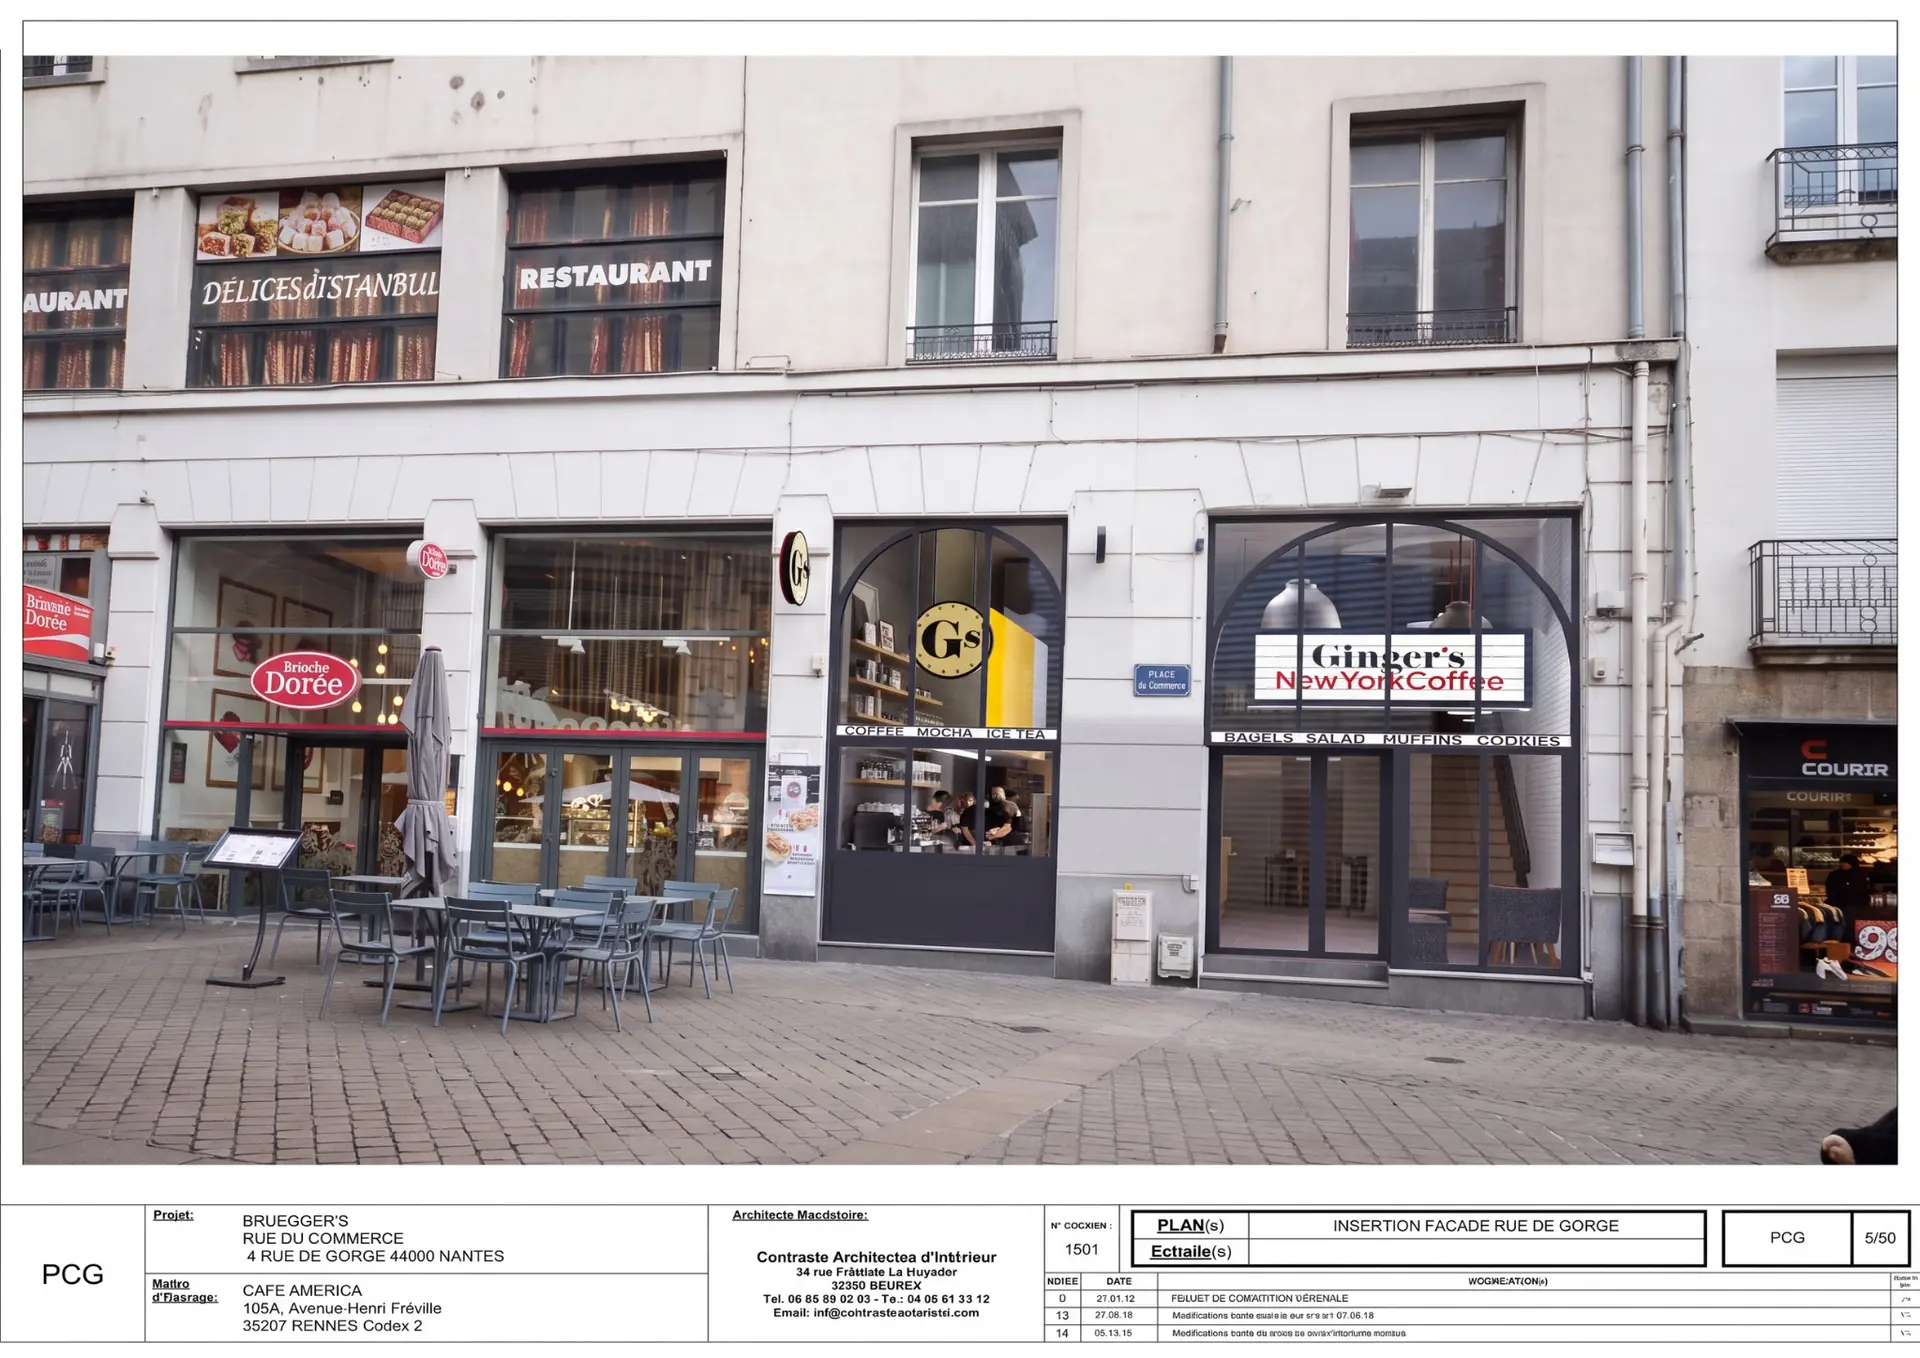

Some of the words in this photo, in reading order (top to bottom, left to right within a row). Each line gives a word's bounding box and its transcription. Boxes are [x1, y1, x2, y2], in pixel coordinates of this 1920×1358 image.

[520, 259, 712, 290] RESTAURANT
[23, 288, 128, 313] AURANT
[791, 549, 811, 588] Gs
[25, 609, 68, 631] Dorée
[921, 619, 981, 659] Gs
[1312, 643, 1465, 673] Ginger's
[283, 661, 330, 674] Brioche
[1148, 670, 1176, 679] PLACE
[264, 671, 343, 696] Dorée
[1148, 681, 1186, 690] Commerce
[844, 725, 905, 736] COFFEE
[917, 727, 973, 738] MOCHA
[986, 729, 1011, 739] ICE
[1016, 730, 1045, 740] TEA
[1224, 732, 1294, 744] BAGELS
[1306, 733, 1365, 745] SALAD
[1383, 734, 1463, 746] MUFFINS
[1801, 762, 1889, 777] COURIR
[152, 1209, 195, 1223] Projet:
[243, 1214, 349, 1228] BRUEGGER'S
[732, 1209, 794, 1222] Architecte
[1157, 1218, 1225, 1234] PLAN(s)
[1333, 1219, 1421, 1233] INSERTION
[1425, 1219, 1490, 1233] FACADE
[1494, 1219, 1528, 1233] RUE
[1532, 1219, 1555, 1233] DE
[1559, 1219, 1620, 1233] GORGE
[243, 1232, 277, 1245] RUE
[281, 1232, 304, 1245] DU
[308, 1232, 404, 1245] COMMERCE
[1770, 1231, 1806, 1244] PCG
[1865, 1231, 1897, 1245] 5/50
[1065, 1243, 1099, 1256] 1501
[247, 1250, 257, 1263] 4
[261, 1250, 295, 1263] RUE
[299, 1250, 322, 1263] DE
[325, 1250, 386, 1263] GORGE
[389, 1250, 435, 1263] 44000
[439, 1250, 505, 1263] NANTES
[757, 1250, 829, 1264] Contraste
[833, 1250, 917, 1264] Architectea
[42, 1263, 104, 1286] PCG
[796, 1267, 811, 1278] 34
[813, 1269, 833, 1278] rue
[888, 1267, 903, 1278] La
[831, 1280, 866, 1291] 32350
[869, 1280, 922, 1291] BEUREX
[1106, 1277, 1133, 1287] DATE
[242, 1284, 286, 1297] CAFE
[288, 1284, 363, 1297] AMERICA
[763, 1294, 785, 1304] Tel.
[787, 1294, 803, 1304] 06
[804, 1294, 820, 1304] 85
[822, 1294, 837, 1304] 89
[839, 1294, 854, 1304] 02
[856, 1294, 871, 1304] 03
[907, 1294, 922, 1304] 04
[924, 1294, 939, 1304] 05
[941, 1294, 954, 1304] 61
[958, 1294, 973, 1304] 33
[976, 1294, 990, 1304] 12
[1096, 1294, 1135, 1303] 27.01.12
[1212, 1294, 1226, 1303] DE
[243, 1302, 284, 1316] 105A,
[288, 1302, 386, 1315] Avenue-Henri
[391, 1301, 442, 1315] Fréville
[773, 1307, 810, 1318] Email:
[1056, 1310, 1070, 1320] 13
[1095, 1310, 1133, 1319] 27.08.18
[1336, 1311, 1375, 1320] 07.06.18
[242, 1319, 287, 1332] 35207
[292, 1319, 358, 1332] RENNES
[363, 1319, 410, 1332] Codex
[413, 1319, 423, 1332] 2
[1056, 1328, 1069, 1338] 14
[1095, 1328, 1133, 1337] 05.13.15
